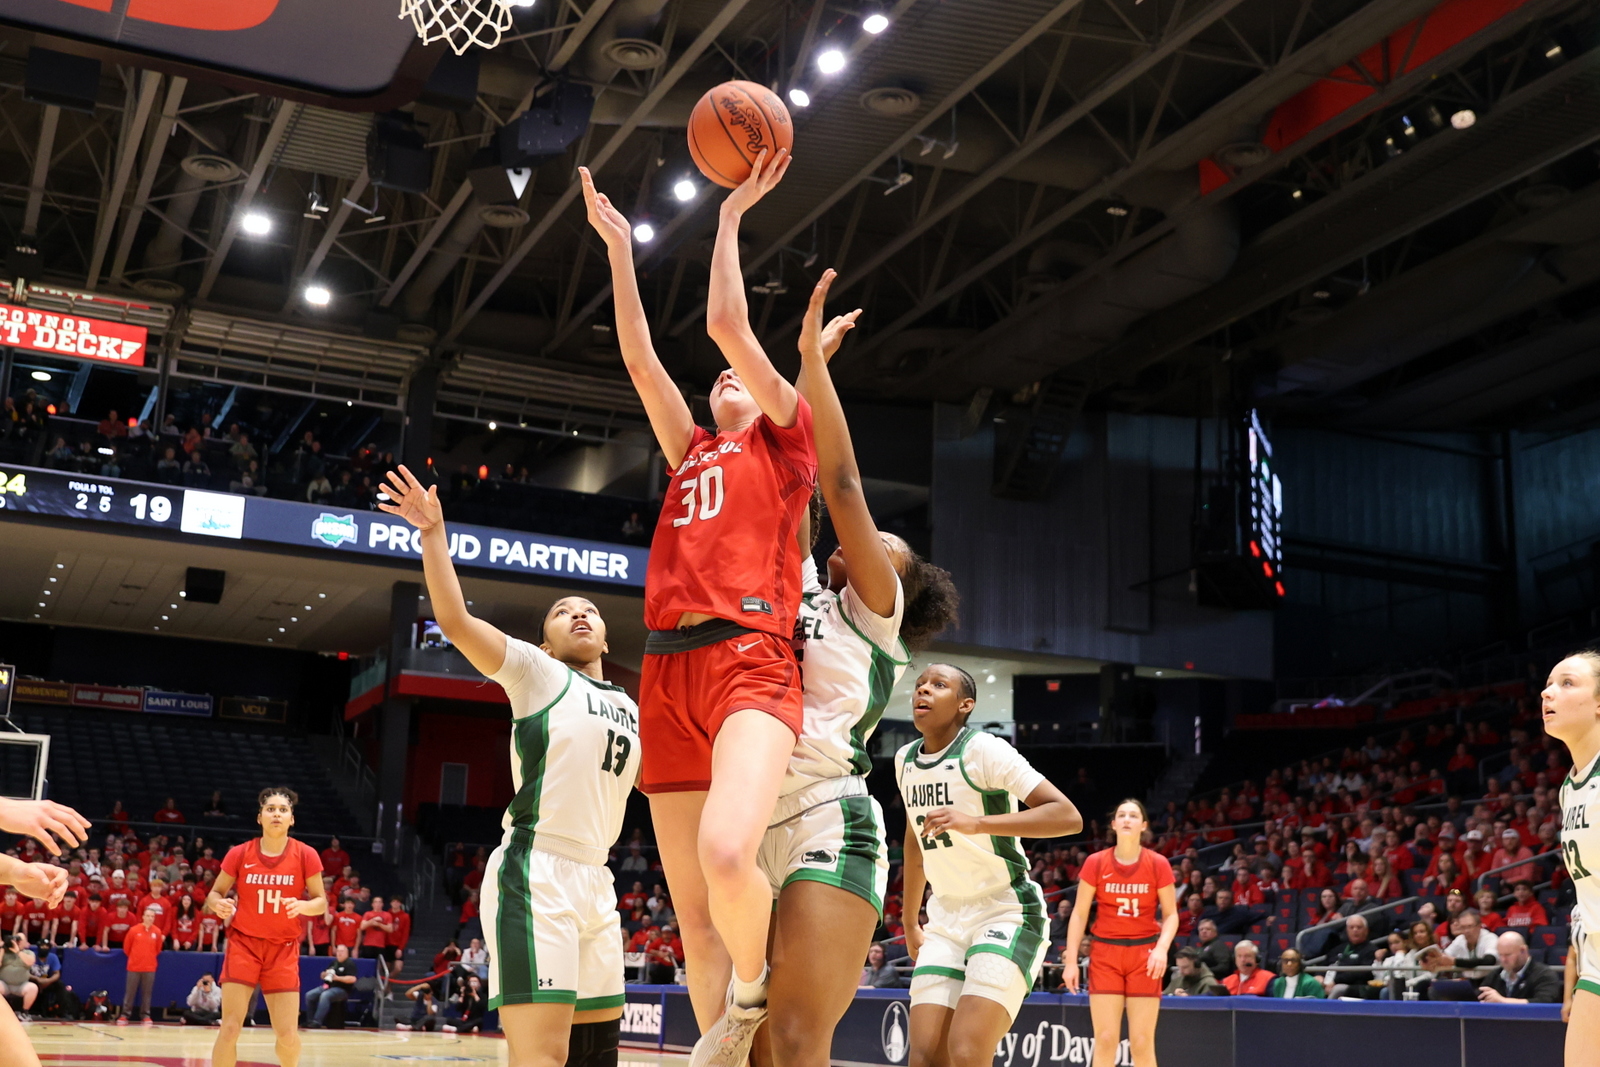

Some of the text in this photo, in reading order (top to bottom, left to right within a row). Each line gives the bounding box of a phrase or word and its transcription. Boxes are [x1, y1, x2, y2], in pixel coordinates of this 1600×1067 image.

[720, 96, 768, 153] Rawlings
[0, 307, 91, 334] CONNOR
[32, 325, 122, 360] DECK
[75, 493, 111, 512] 2 5
[129, 493, 172, 522] 19
[672, 465, 724, 528] 30
[489, 537, 629, 579] PARTNER
[148, 696, 210, 711] SAINT LOUIS
[241, 703, 267, 715] VCU
[586, 692, 637, 735] LAURE
[600, 728, 632, 778] 13
[906, 781, 954, 808] LAUREL
[245, 873, 295, 886] BELLEVUE
[1104, 882, 1150, 895] BELLEVUE
[257, 889, 281, 914] 14
[1116, 897, 1140, 918] 21
[1022, 1021, 1049, 1067] of
